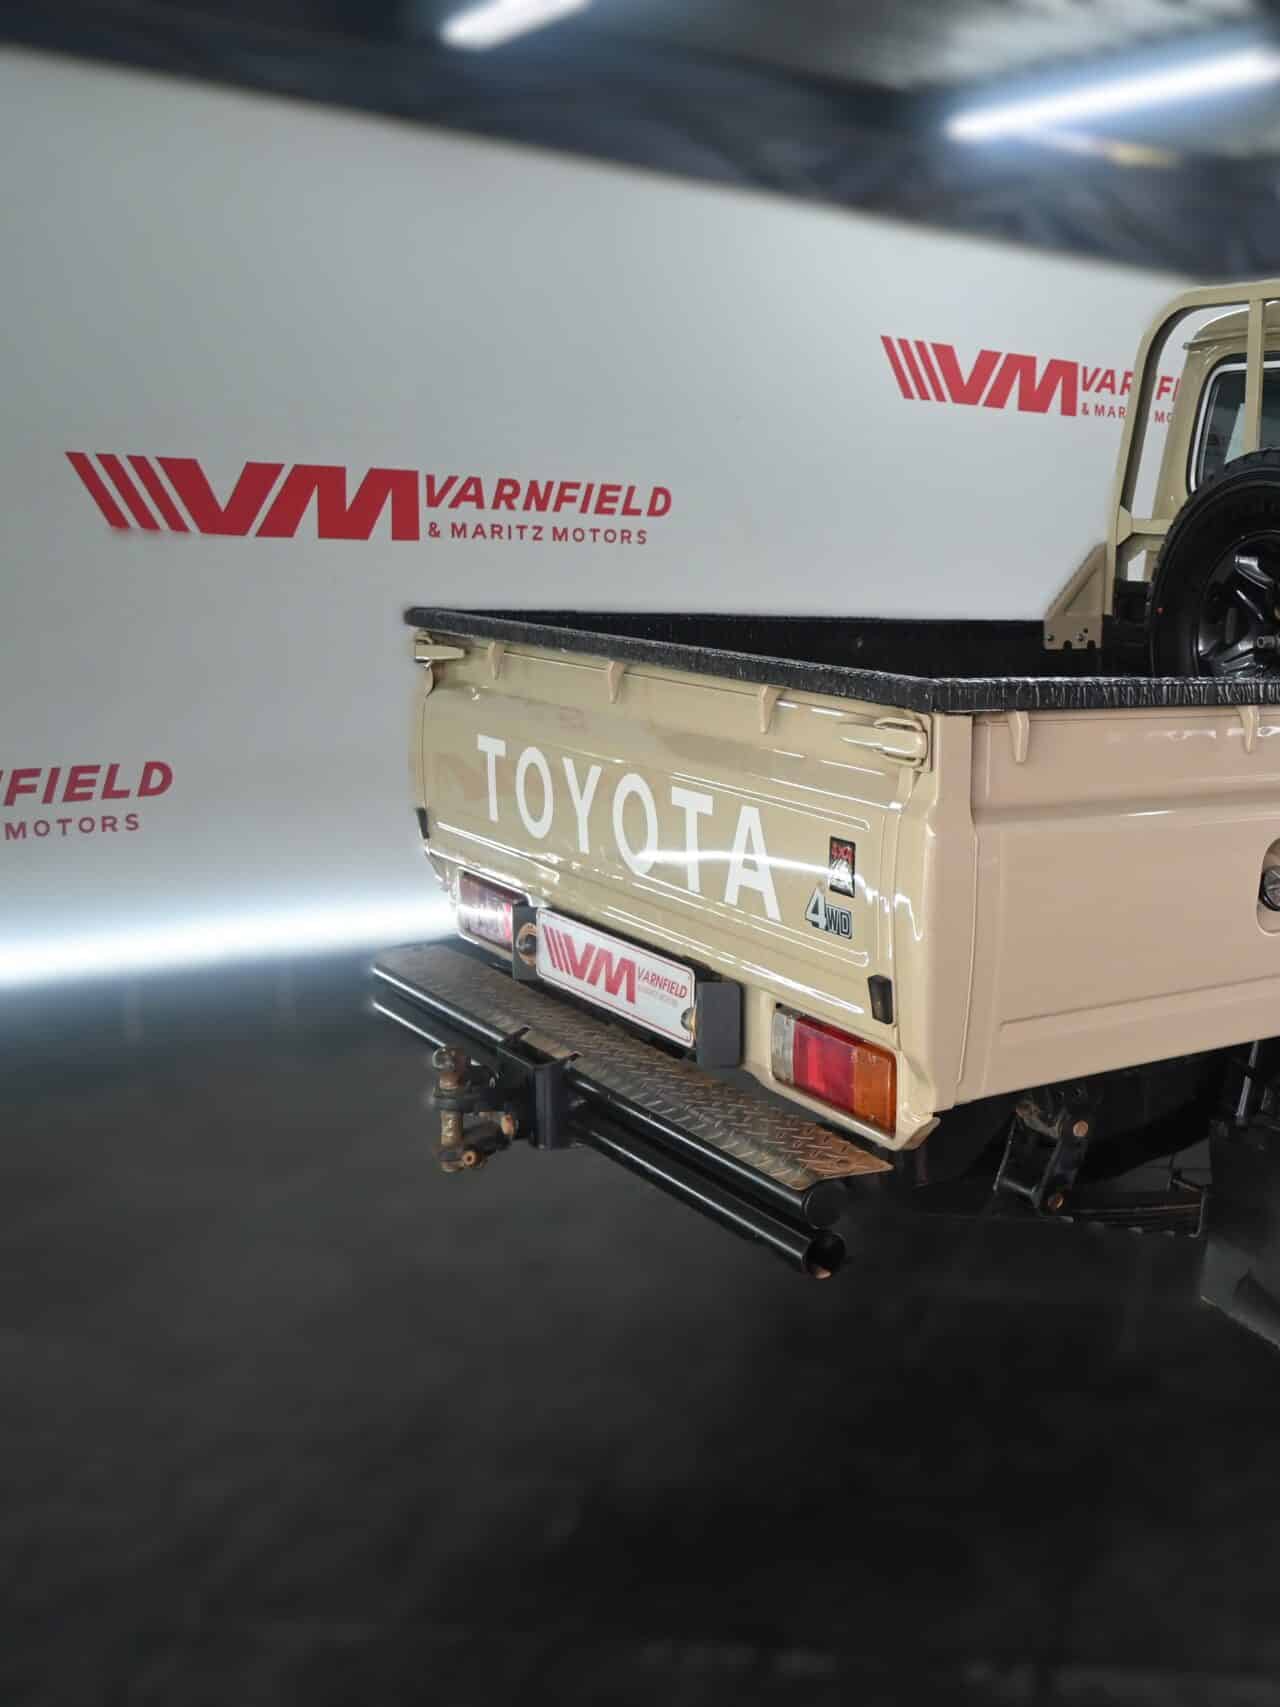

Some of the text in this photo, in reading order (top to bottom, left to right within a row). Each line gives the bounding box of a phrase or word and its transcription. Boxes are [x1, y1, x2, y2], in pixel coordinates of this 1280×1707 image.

[1082, 366, 1181, 402] VARFI
[1095, 404, 1127, 418] MAR
[425, 474, 672, 517] VARNFIELD
[428, 521, 648, 545] & MARITZ MOTORS
[0, 761, 174, 806] FIELD
[4, 813, 140, 840] MOTORS
[477, 734, 782, 922] TOYOTA
[805, 887, 852, 939] 4WD
[638, 965, 688, 999] VARNFIELD
